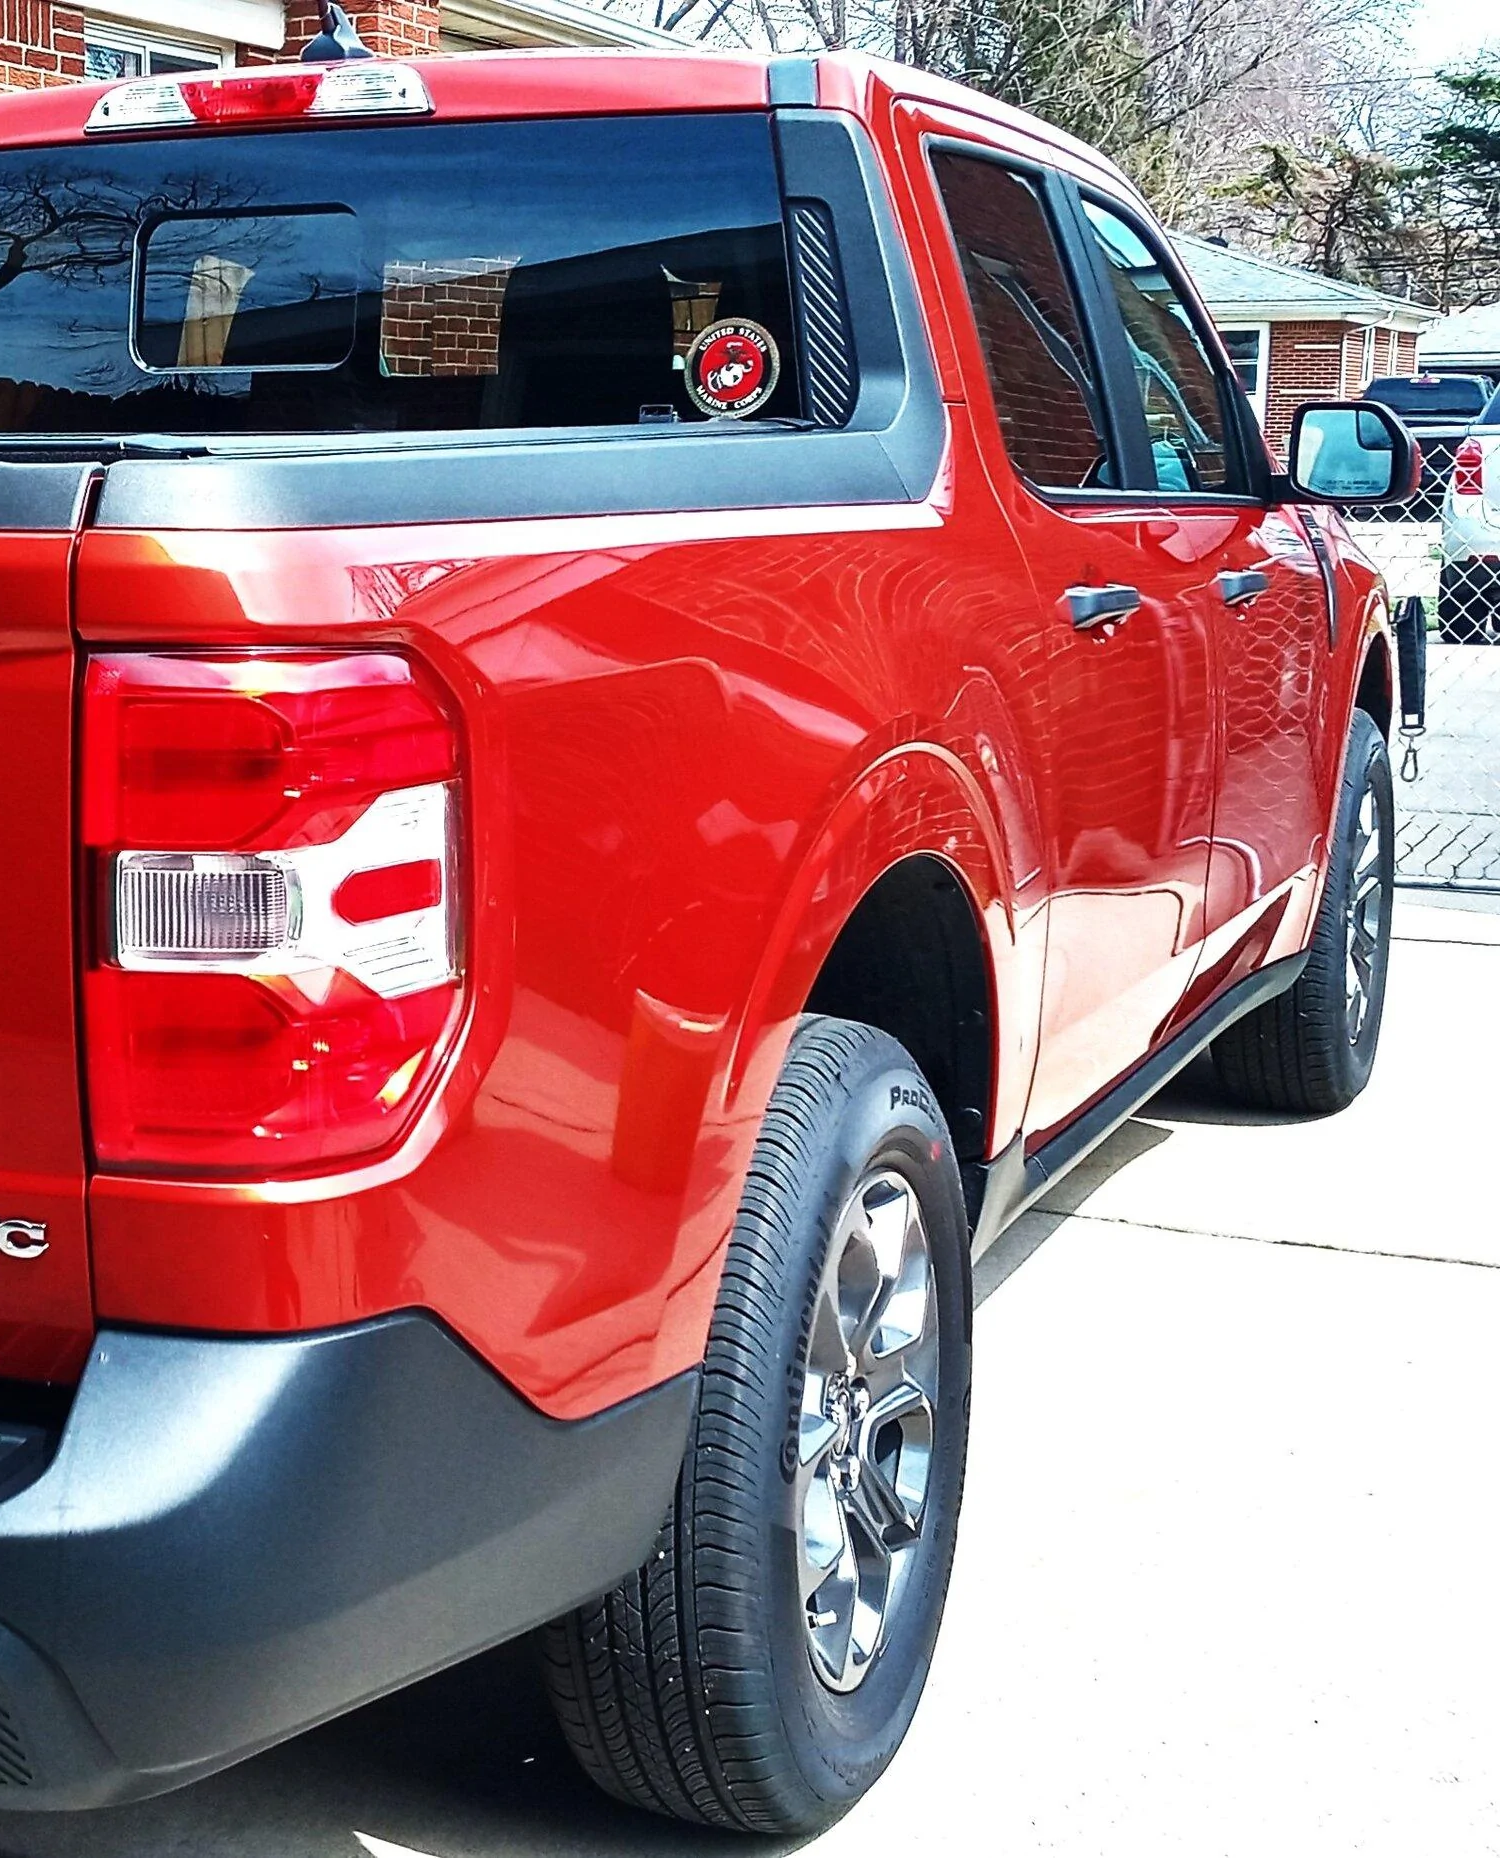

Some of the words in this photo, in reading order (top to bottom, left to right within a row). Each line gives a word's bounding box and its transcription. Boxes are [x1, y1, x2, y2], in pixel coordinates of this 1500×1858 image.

[699, 326, 735, 351] UNITED
[739, 327, 768, 353] STATES
[695, 384, 728, 410] MARINE
[733, 386, 763, 409] CORPS
